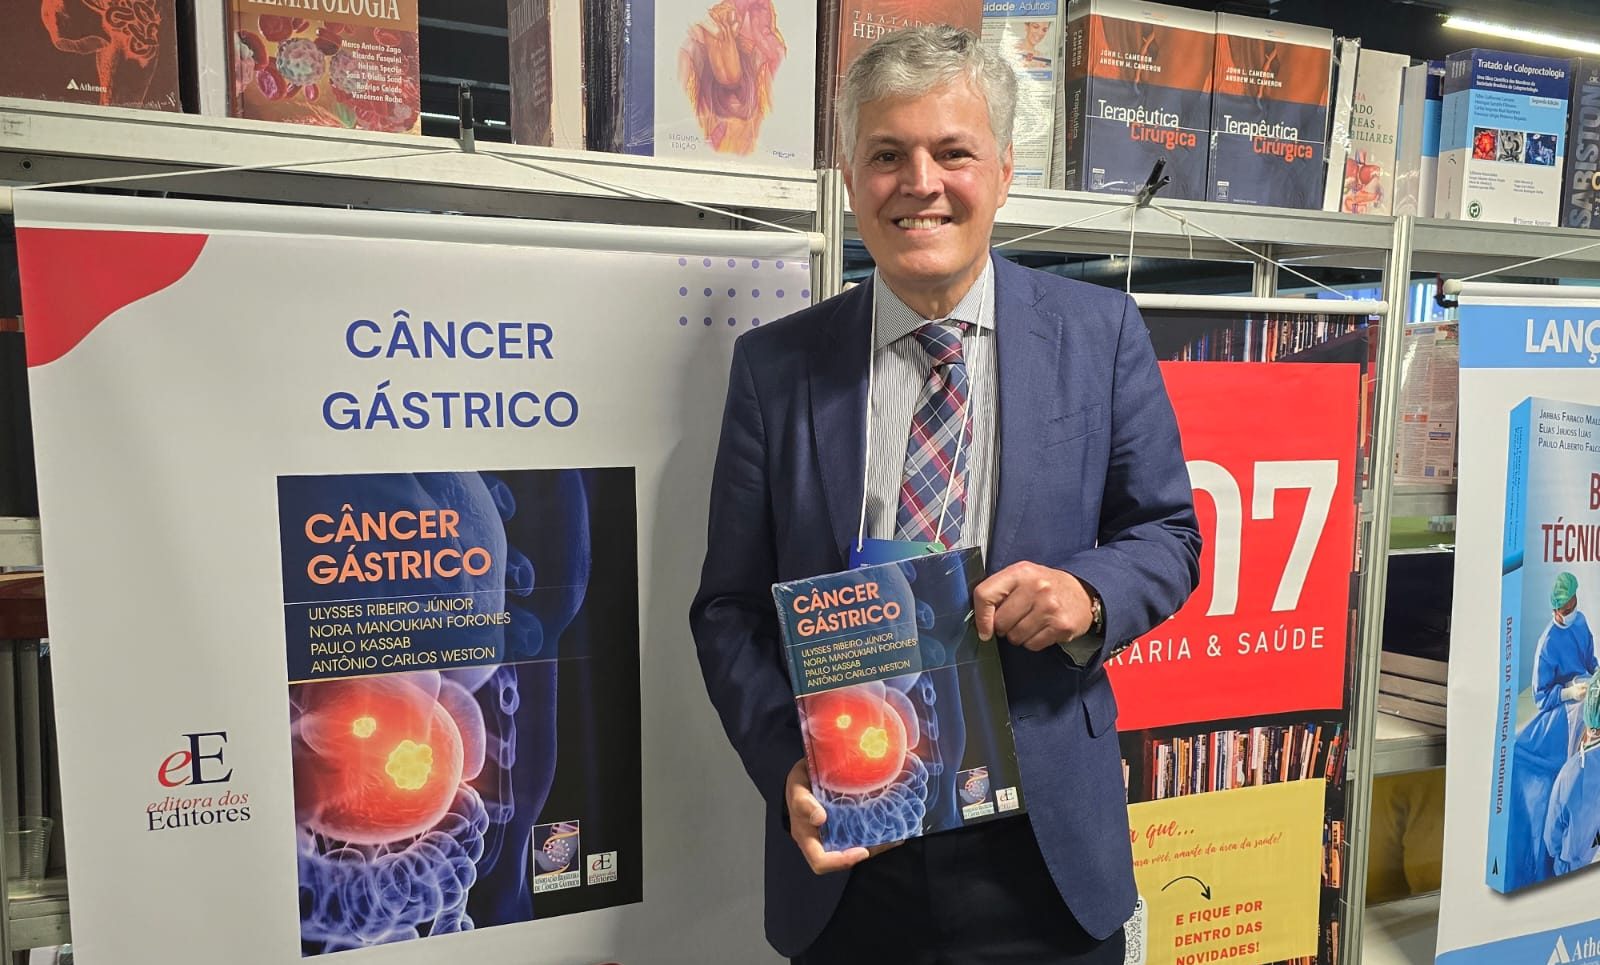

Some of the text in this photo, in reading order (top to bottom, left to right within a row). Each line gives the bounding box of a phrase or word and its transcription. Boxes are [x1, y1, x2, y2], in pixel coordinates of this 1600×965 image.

[341, 40, 402, 55] Marco Antonio Zago
[352, 51, 402, 64] Ricardo Pasquini
[1100, 49, 1116, 58] JOHN
[1125, 53, 1153, 63] CAMERON
[1100, 57, 1124, 67] ANDREW
[1133, 62, 1161, 73] CAMERON
[1226, 66, 1241, 75] JOHN
[1248, 69, 1275, 79] CAMERON
[1478, 59, 1502, 71] Tratado
[1503, 62, 1512, 71] de
[1513, 63, 1565, 80] Coloproctologia
[352, 91, 384, 101] Vanderson
[356, 82, 380, 93] Rodrigo
[1256, 79, 1282, 88] CAMERON
[1098, 99, 1179, 127] Terapêutica
[668, 133, 699, 143] SEGUNDA
[1130, 122, 1196, 150] Cirúrgica
[1224, 115, 1298, 141] Terapêutica
[1350, 130, 1394, 145] BILIARES
[1253, 136, 1312, 162] Cirúrgica
[345, 308, 554, 360] CÂNCER
[1525, 318, 1600, 365] LANÇ
[322, 379, 579, 430] GÁSTRICO
[304, 503, 460, 544] CÂNCER
[306, 544, 492, 585] GÁSTRICO
[309, 596, 474, 620] ULYSSES RIBEIRO JÚNIOR
[793, 582, 880, 614] CÂNCER
[310, 611, 511, 638] NORA MANOUKIAN FORONES
[797, 602, 900, 637] GÁSTRICO
[311, 636, 412, 655] PAULO KASSAB
[801, 633, 893, 658] ULYSSES RIBEIRO JÚNIOR
[1206, 634, 1221, 657] &
[1237, 624, 1324, 654] SAÚDE
[1505, 616, 1514, 660] BASES
[311, 646, 496, 673] ANTÔNIO CARLOS WESTON
[803, 638, 918, 667] NORA MANOUKIAN FORONES
[805, 659, 861, 677] PAULO KASSAB
[807, 659, 911, 688] ANTÔNIO CARLOS WESTON
[1504, 664, 1513, 683] DA
[158, 731, 233, 787] eE
[147, 789, 249, 813] editora dos
[148, 806, 251, 831] Editores
[1174, 843, 1202, 859] amante
[1205, 843, 1217, 855] da
[1240, 836, 1252, 850] da
[1175, 900, 1263, 926] E FIQUE POR
[1175, 921, 1263, 948] DENTRO DAS
[1176, 942, 1260, 965] NOVIDADES!
